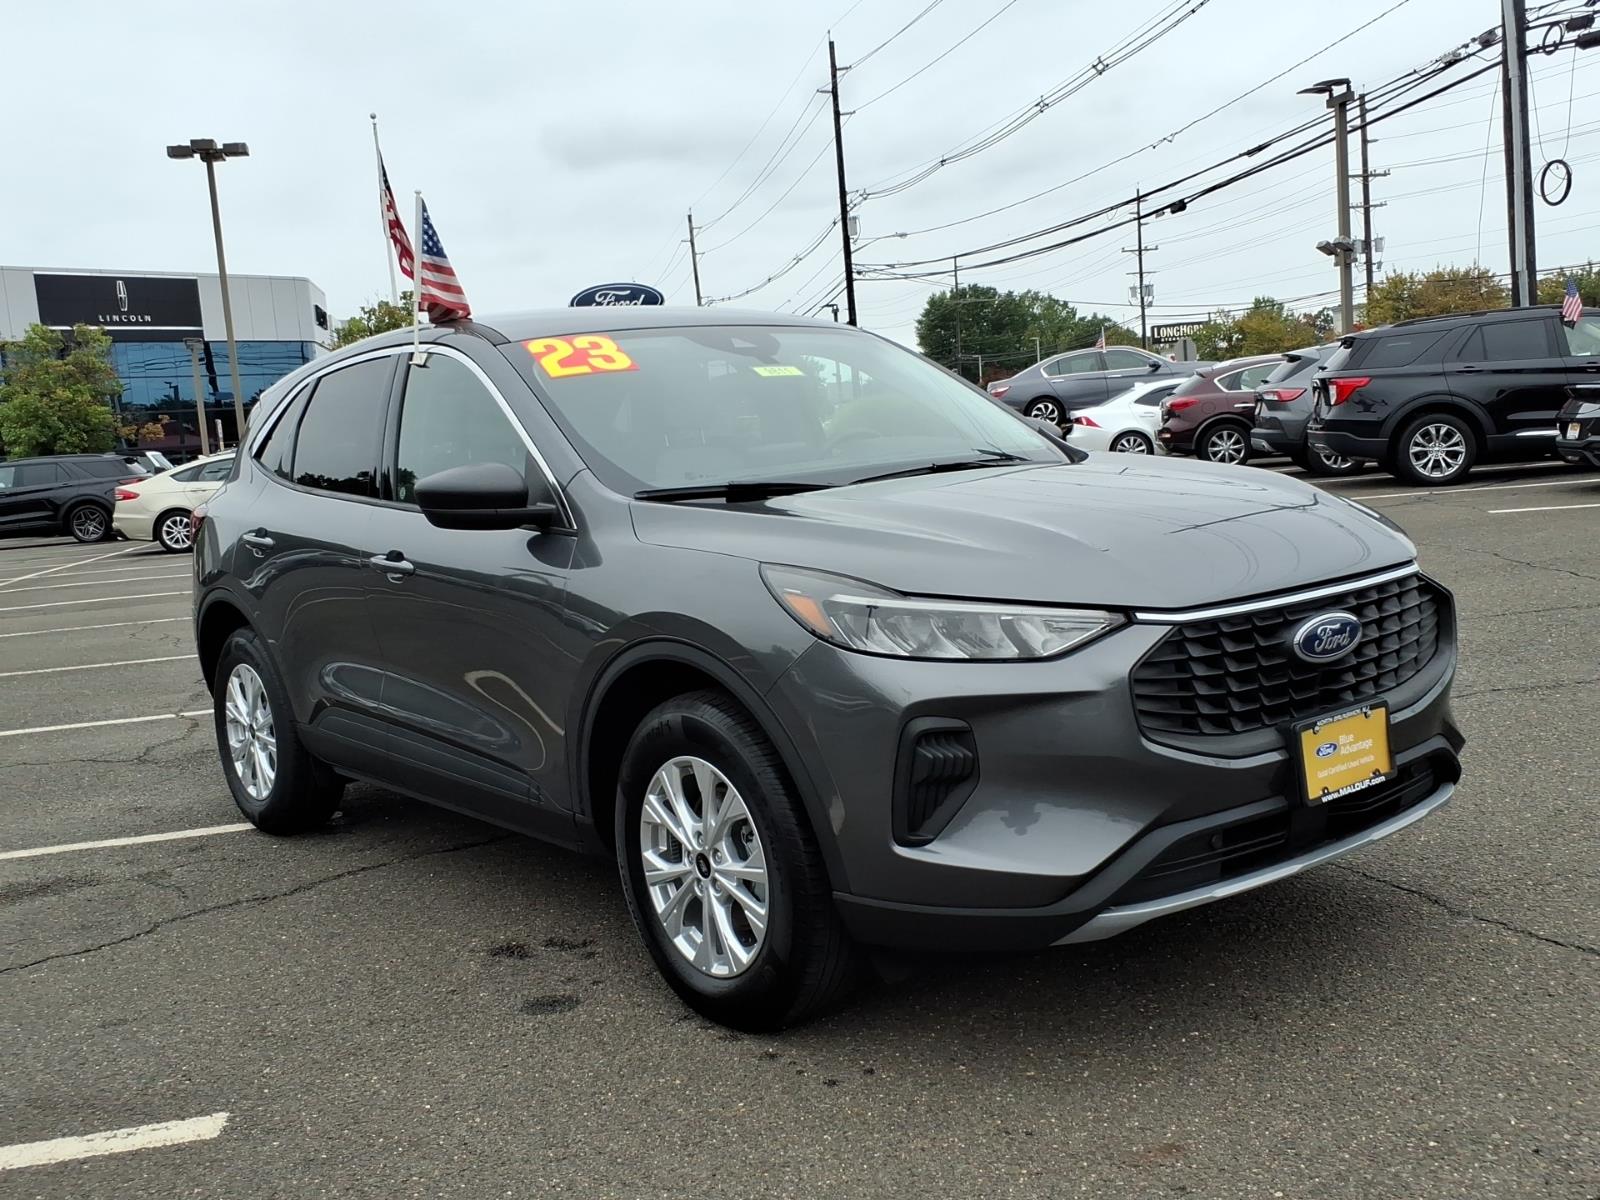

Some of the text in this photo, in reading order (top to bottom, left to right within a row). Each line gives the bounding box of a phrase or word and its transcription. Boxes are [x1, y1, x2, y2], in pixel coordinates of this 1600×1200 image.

[591, 290, 646, 307] Ford
[98, 314, 152, 322] LINCOLN
[527, 335, 632, 378] 23
[1314, 623, 1352, 653] Ford
